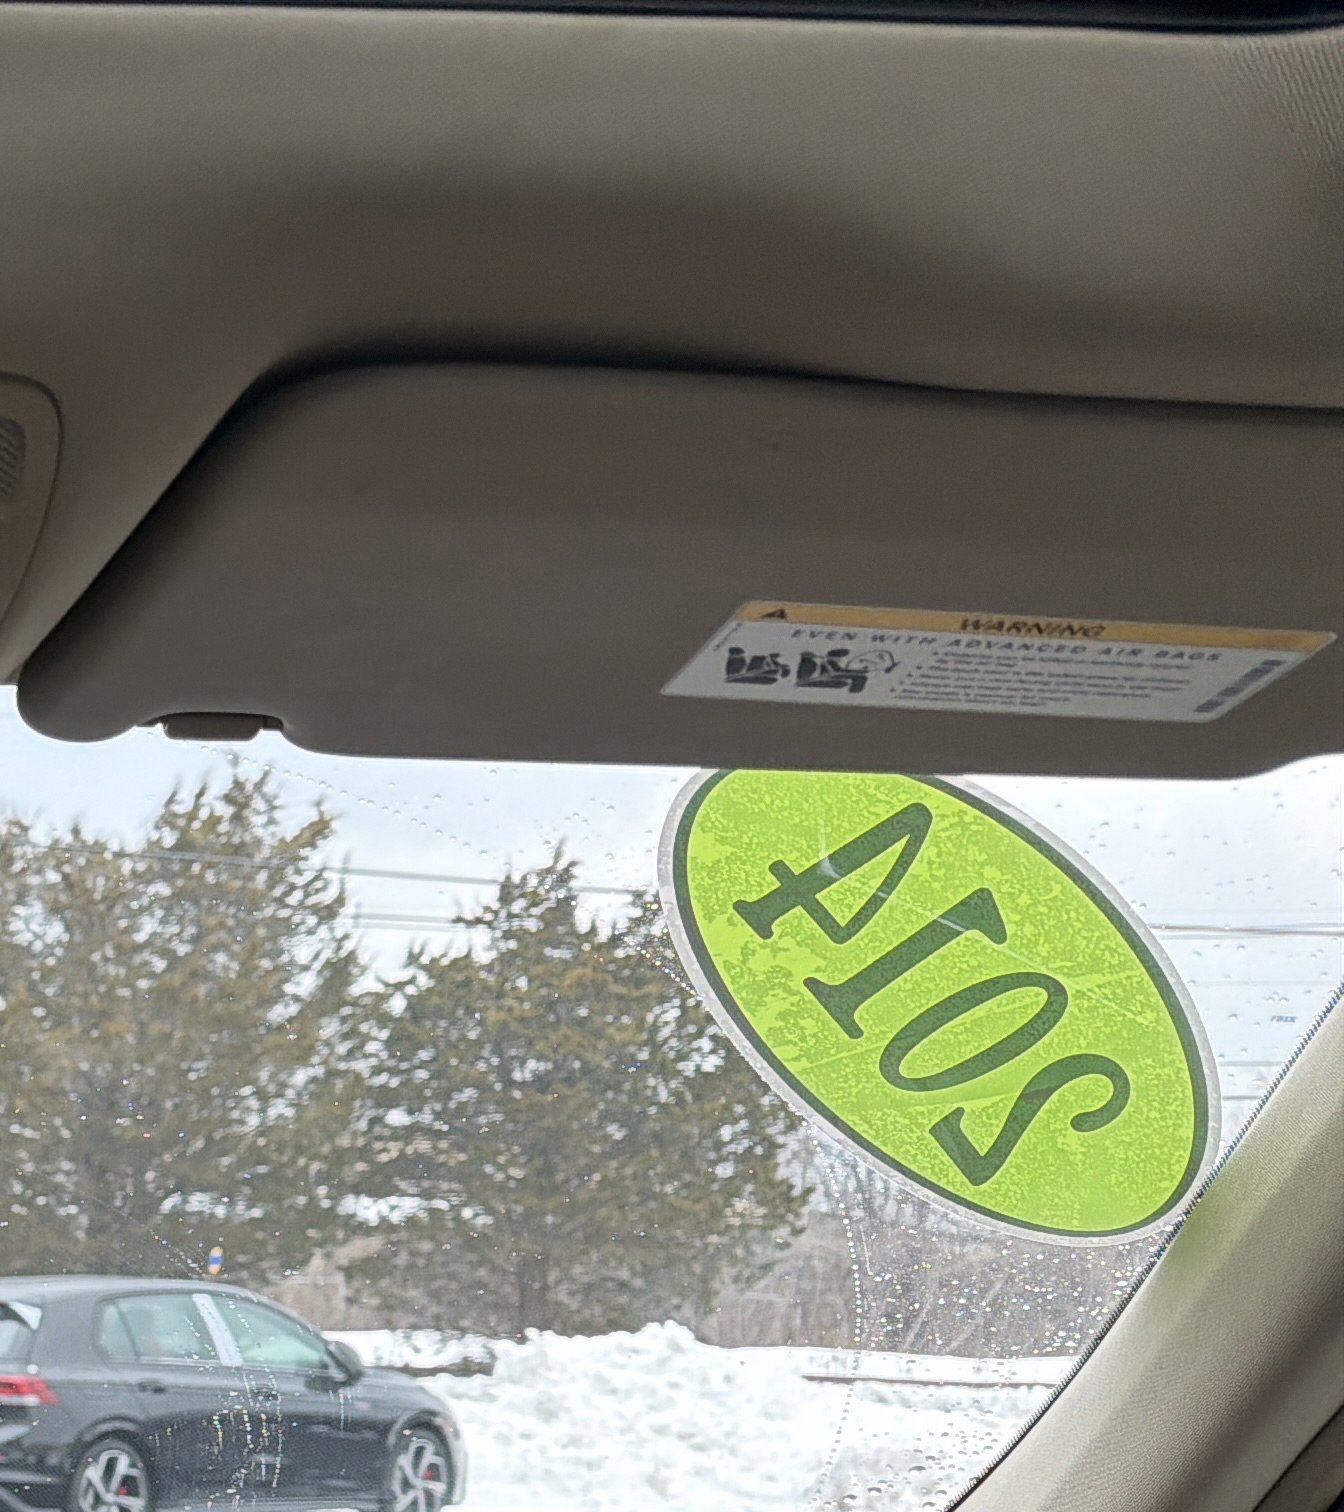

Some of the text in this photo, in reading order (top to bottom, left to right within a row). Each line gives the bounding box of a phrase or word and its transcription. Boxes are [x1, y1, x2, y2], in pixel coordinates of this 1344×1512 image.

[961, 618, 1107, 638] WARNING
[791, 629, 857, 641] EVEN
[871, 634, 937, 645] WITH
[948, 639, 1087, 655] ADVANCED
[1098, 647, 1143, 658] AIR
[1154, 651, 1223, 662] BAGS
